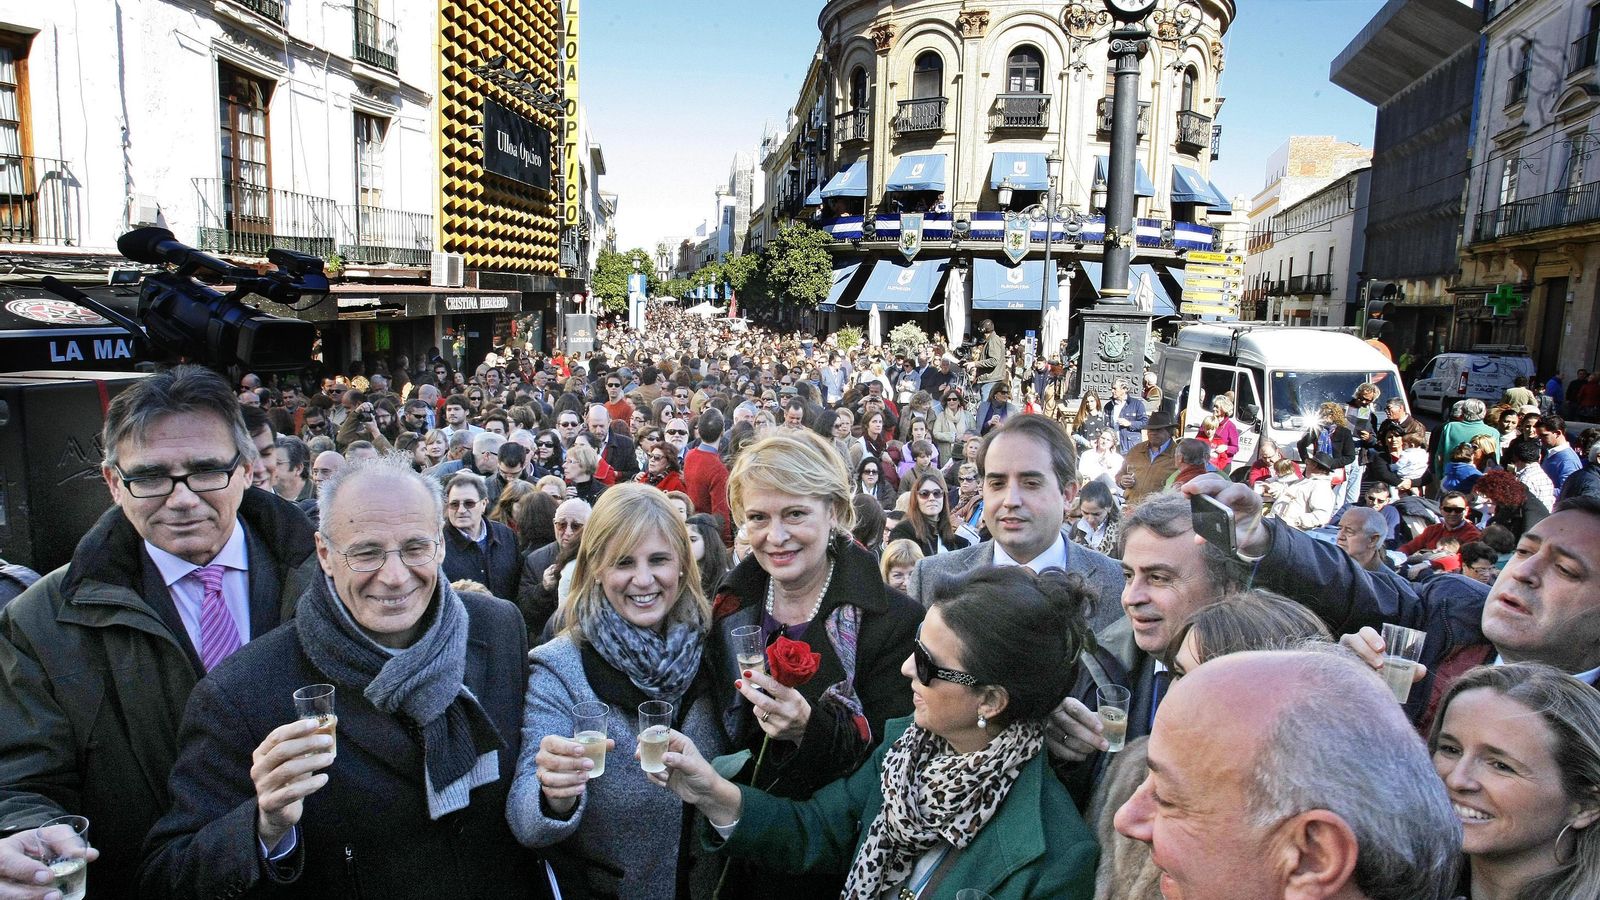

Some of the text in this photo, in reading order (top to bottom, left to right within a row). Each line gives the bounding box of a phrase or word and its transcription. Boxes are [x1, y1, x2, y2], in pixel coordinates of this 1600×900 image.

[497, 129, 518, 157] Ulloa
[565, 99, 578, 222] OPTICO
[445, 296, 508, 310] CRISTINA HERRERO
[50, 339, 134, 362] LA MA
[1091, 362, 1134, 372] PEDRO
